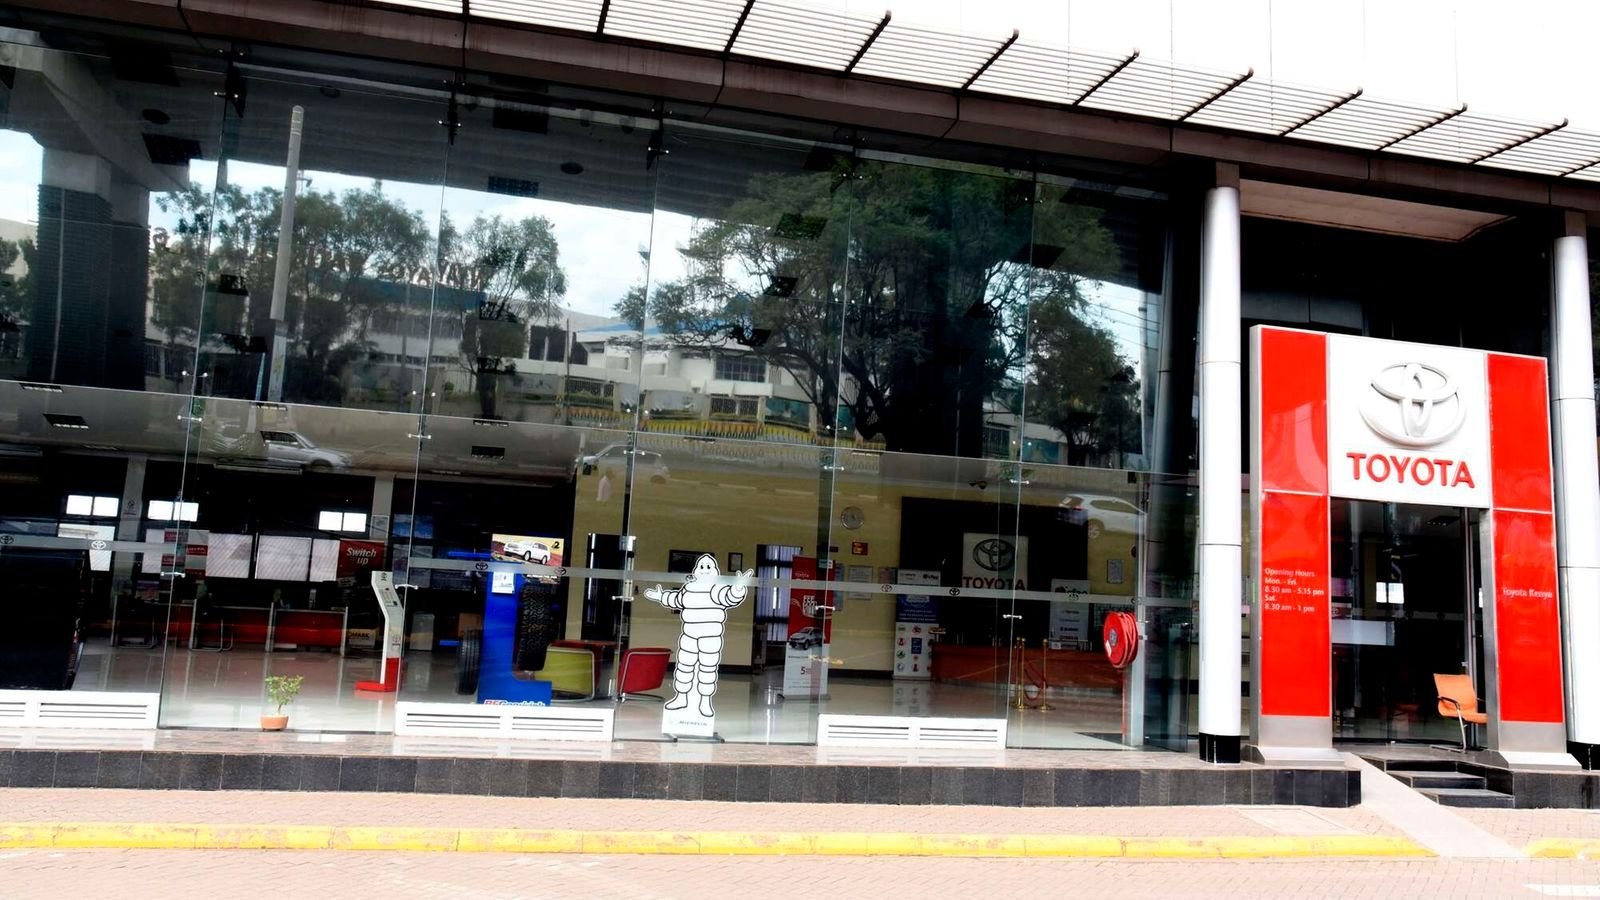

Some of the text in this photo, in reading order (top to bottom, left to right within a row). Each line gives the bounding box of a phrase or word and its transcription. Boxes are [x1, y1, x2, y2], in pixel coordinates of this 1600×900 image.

[1346, 452, 1475, 488] TOYOTA
[346, 547, 377, 558] Switch
[357, 557, 369, 566] up
[1264, 568, 1294, 577] Opening
[962, 576, 1026, 591] TOYOTA
[1264, 585, 1280, 593] 8.30
[1312, 589, 1325, 597] pm
[1503, 587, 1552, 599] Toyota Kenya
[1264, 603, 1280, 611] 8.30
[1303, 606, 1315, 614] pm
